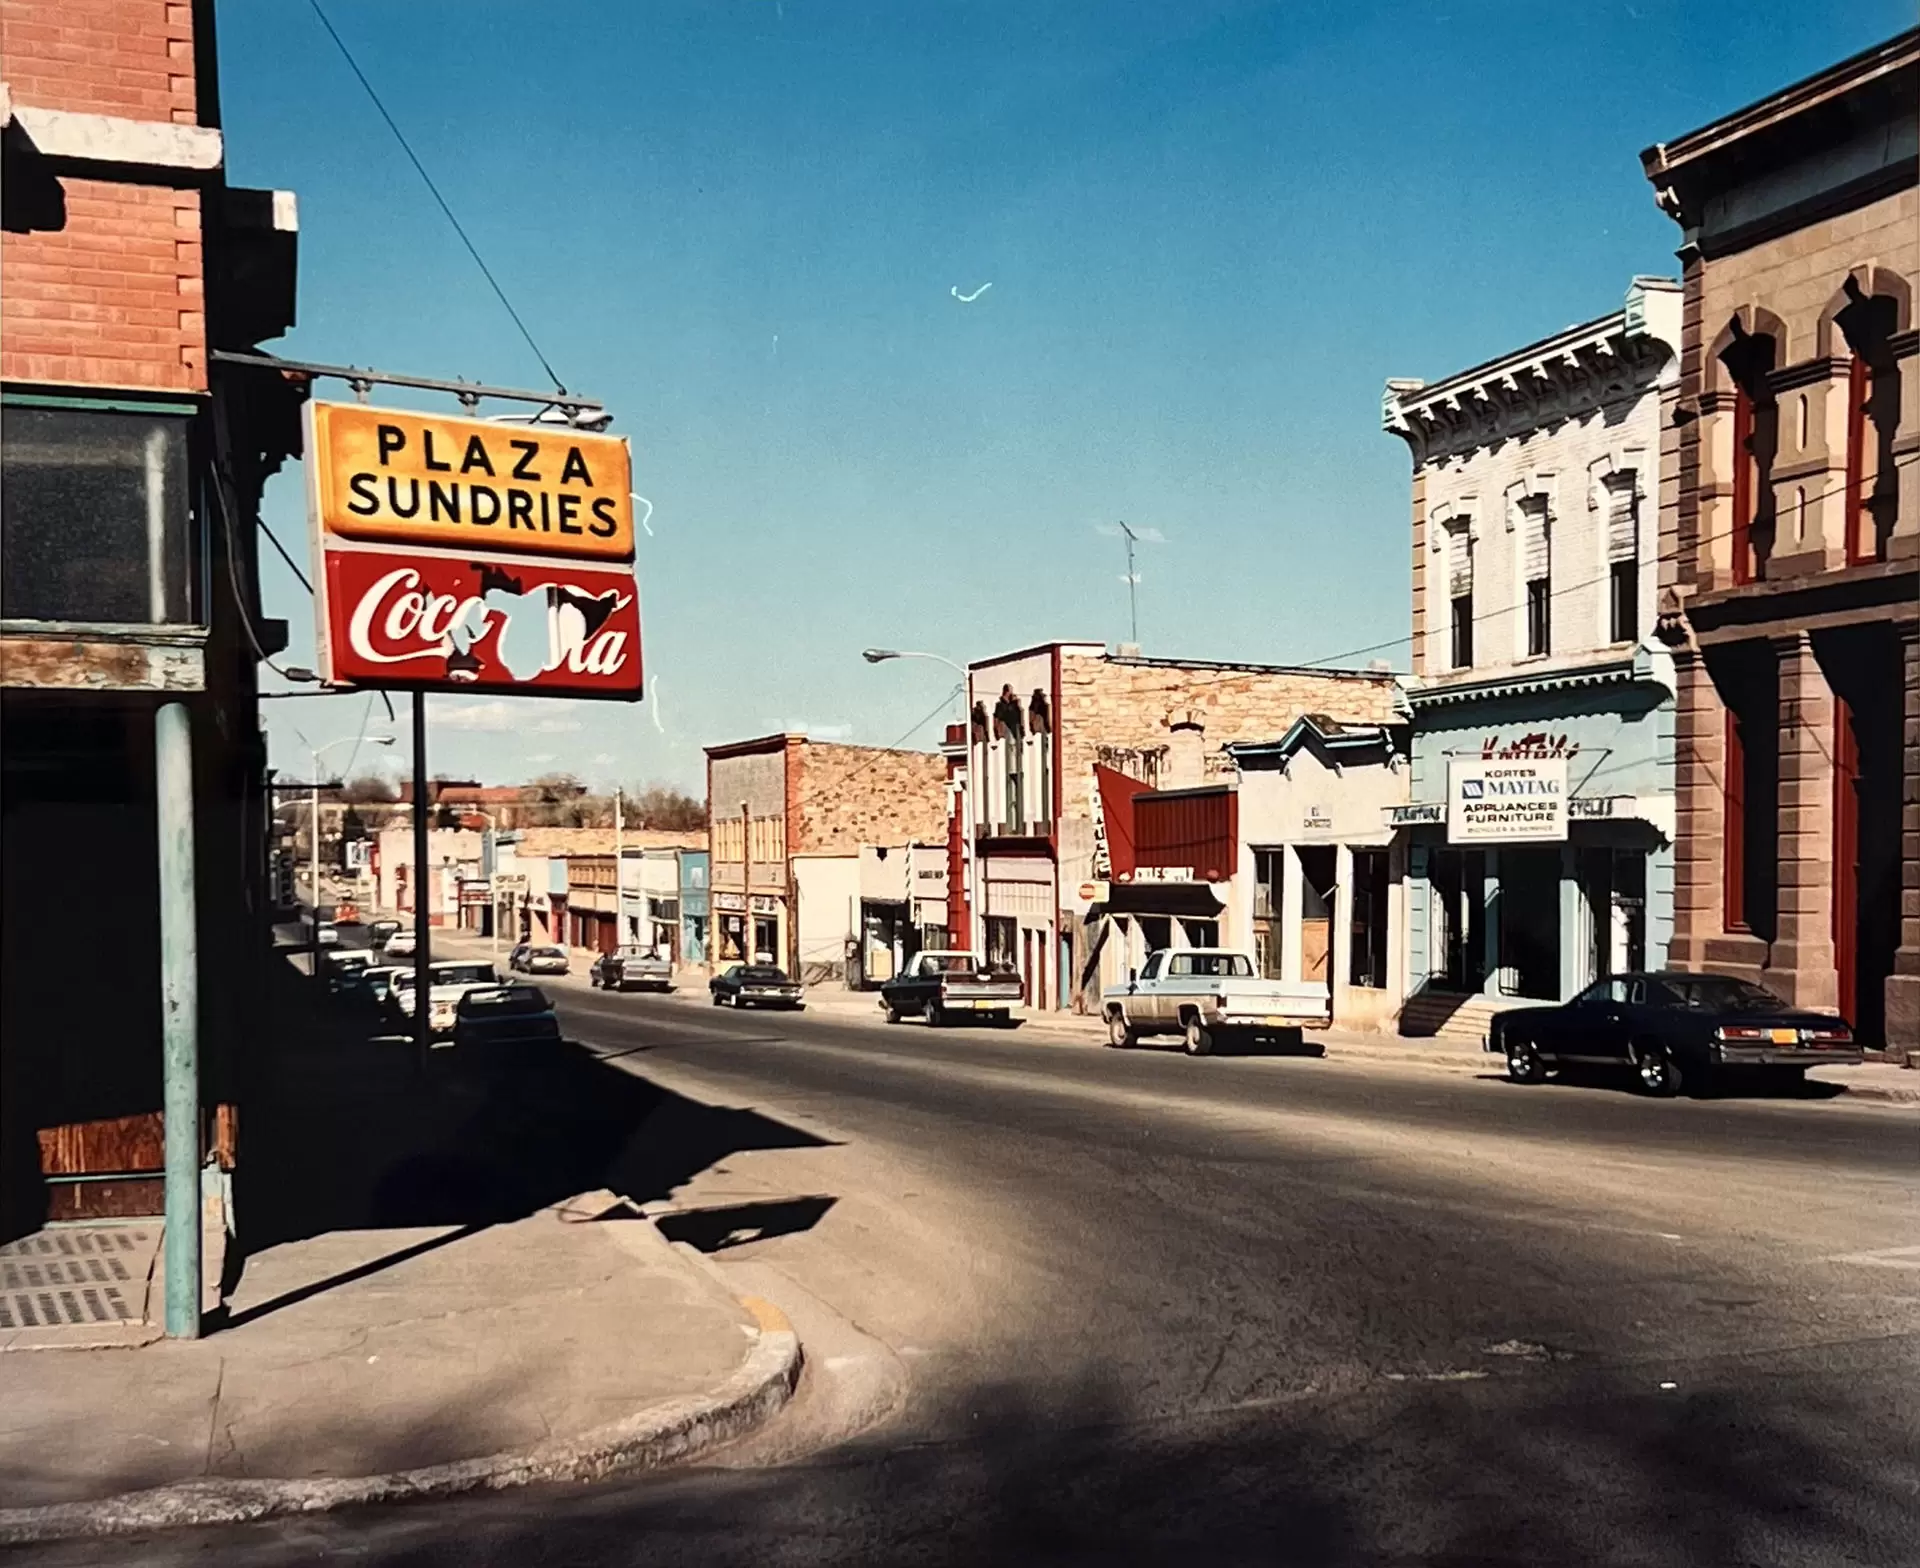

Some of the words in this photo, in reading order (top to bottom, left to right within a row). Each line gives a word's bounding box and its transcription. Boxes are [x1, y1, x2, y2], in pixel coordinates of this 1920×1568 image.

[377, 424, 593, 487] PLAZA
[347, 472, 617, 538] SUNDRIES
[1488, 780, 1560, 797] MAYTAG
[1463, 802, 1558, 813] APPLIANCES
[1466, 812, 1556, 824] FURNITURE
